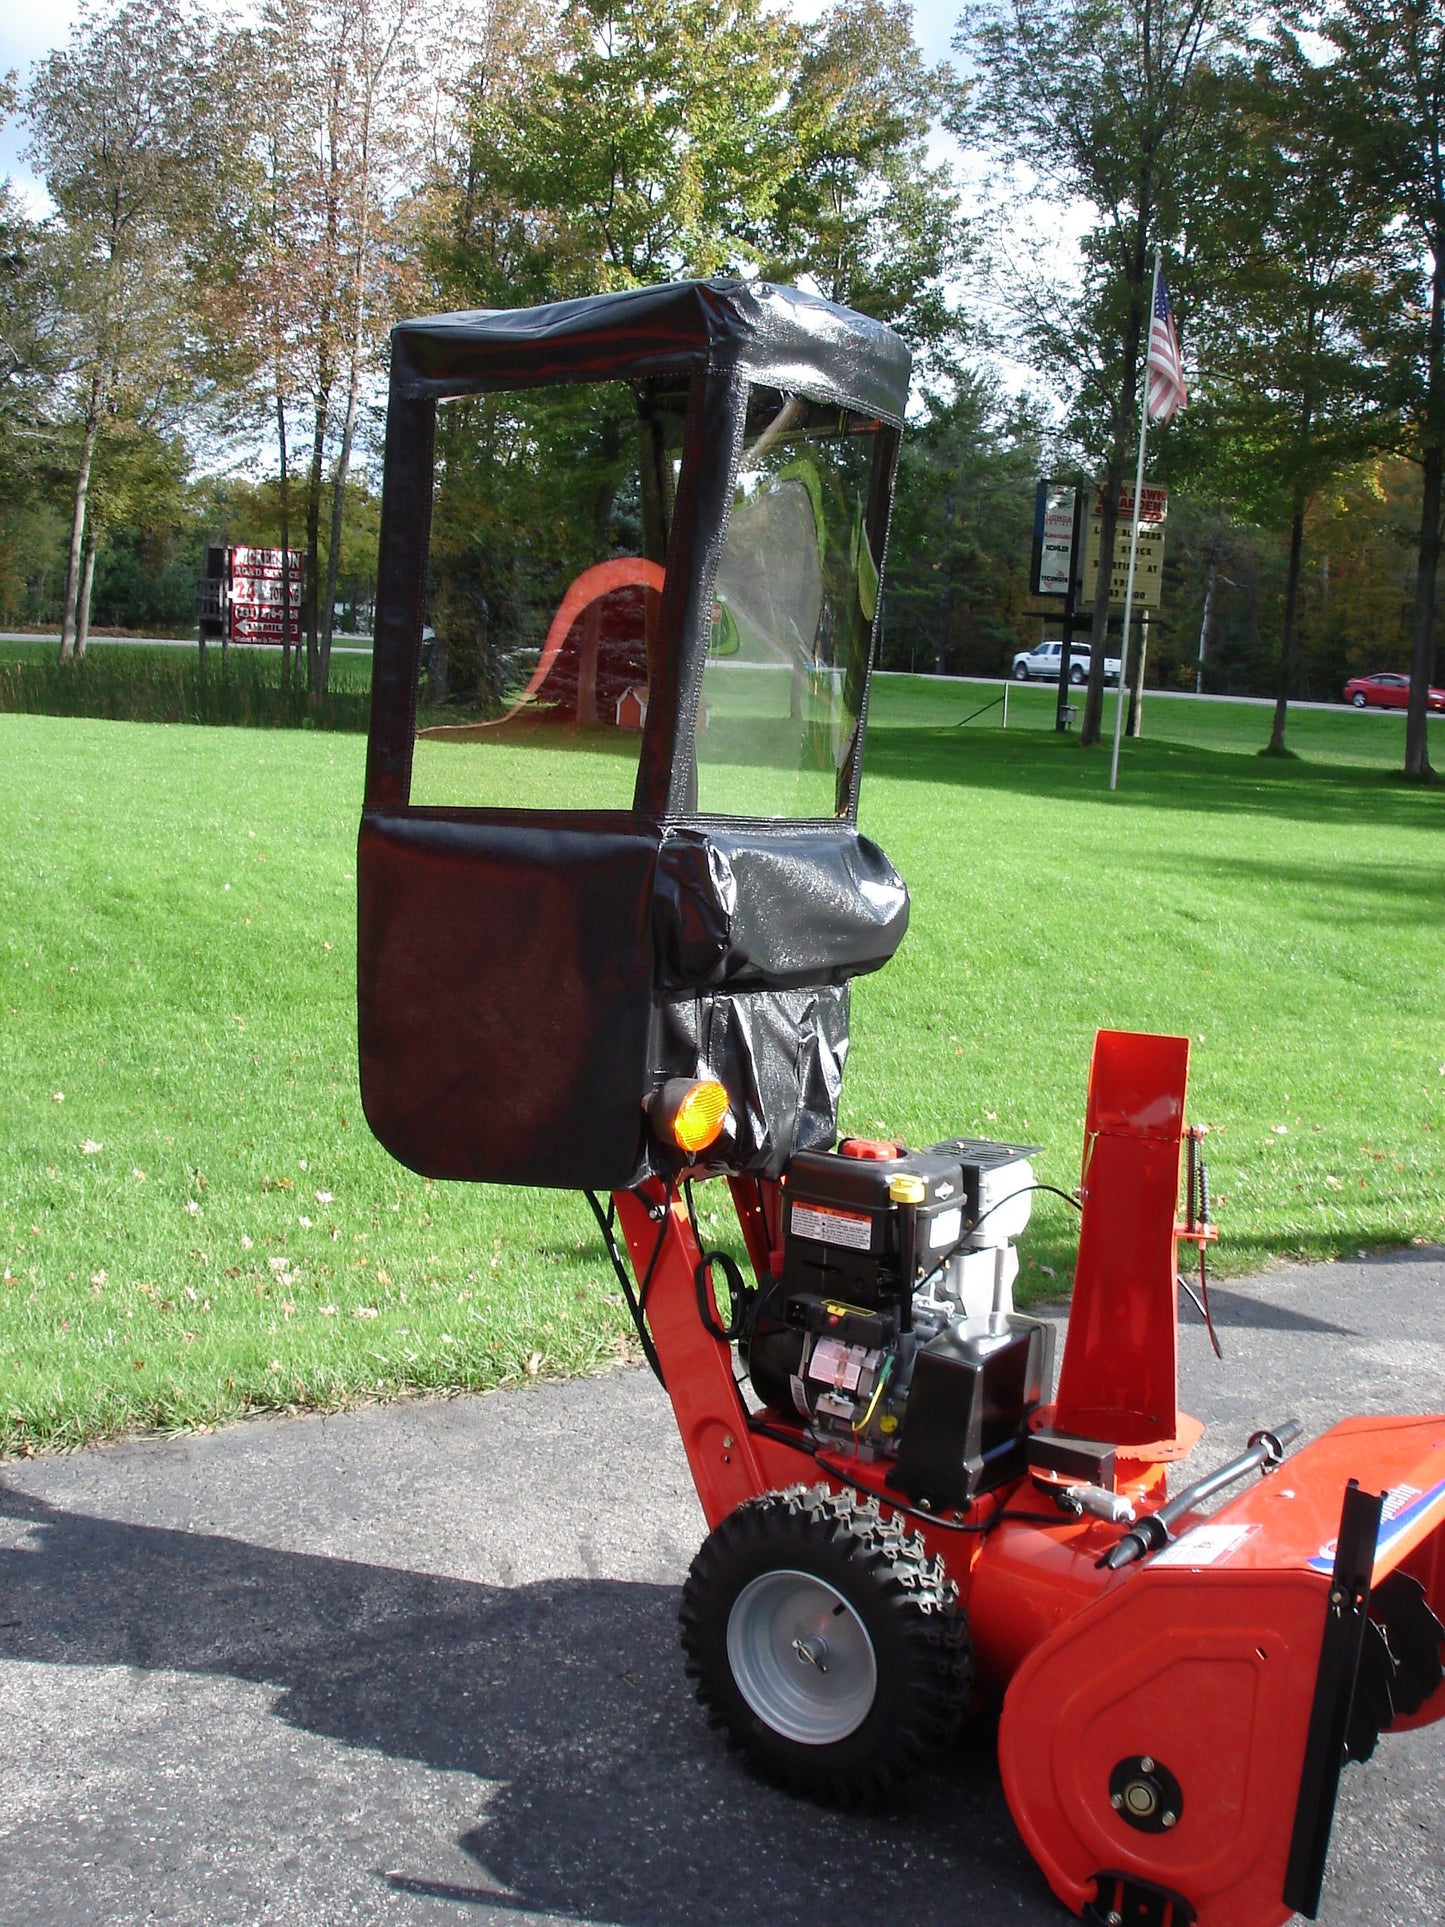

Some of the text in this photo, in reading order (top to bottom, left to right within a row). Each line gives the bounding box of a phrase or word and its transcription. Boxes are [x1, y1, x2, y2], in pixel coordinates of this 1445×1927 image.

[1122, 529, 1162, 540] BLWERS
[235, 566, 300, 579] ROAD SERVCE
[1147, 565, 1158, 573] AT
[235, 581, 256, 602] 24
[270, 587, 299, 602] TOWNG
[235, 605, 260, 620] (231)
[263, 622, 298, 633] MILS
[1380, 1484, 1423, 1525] plicity
